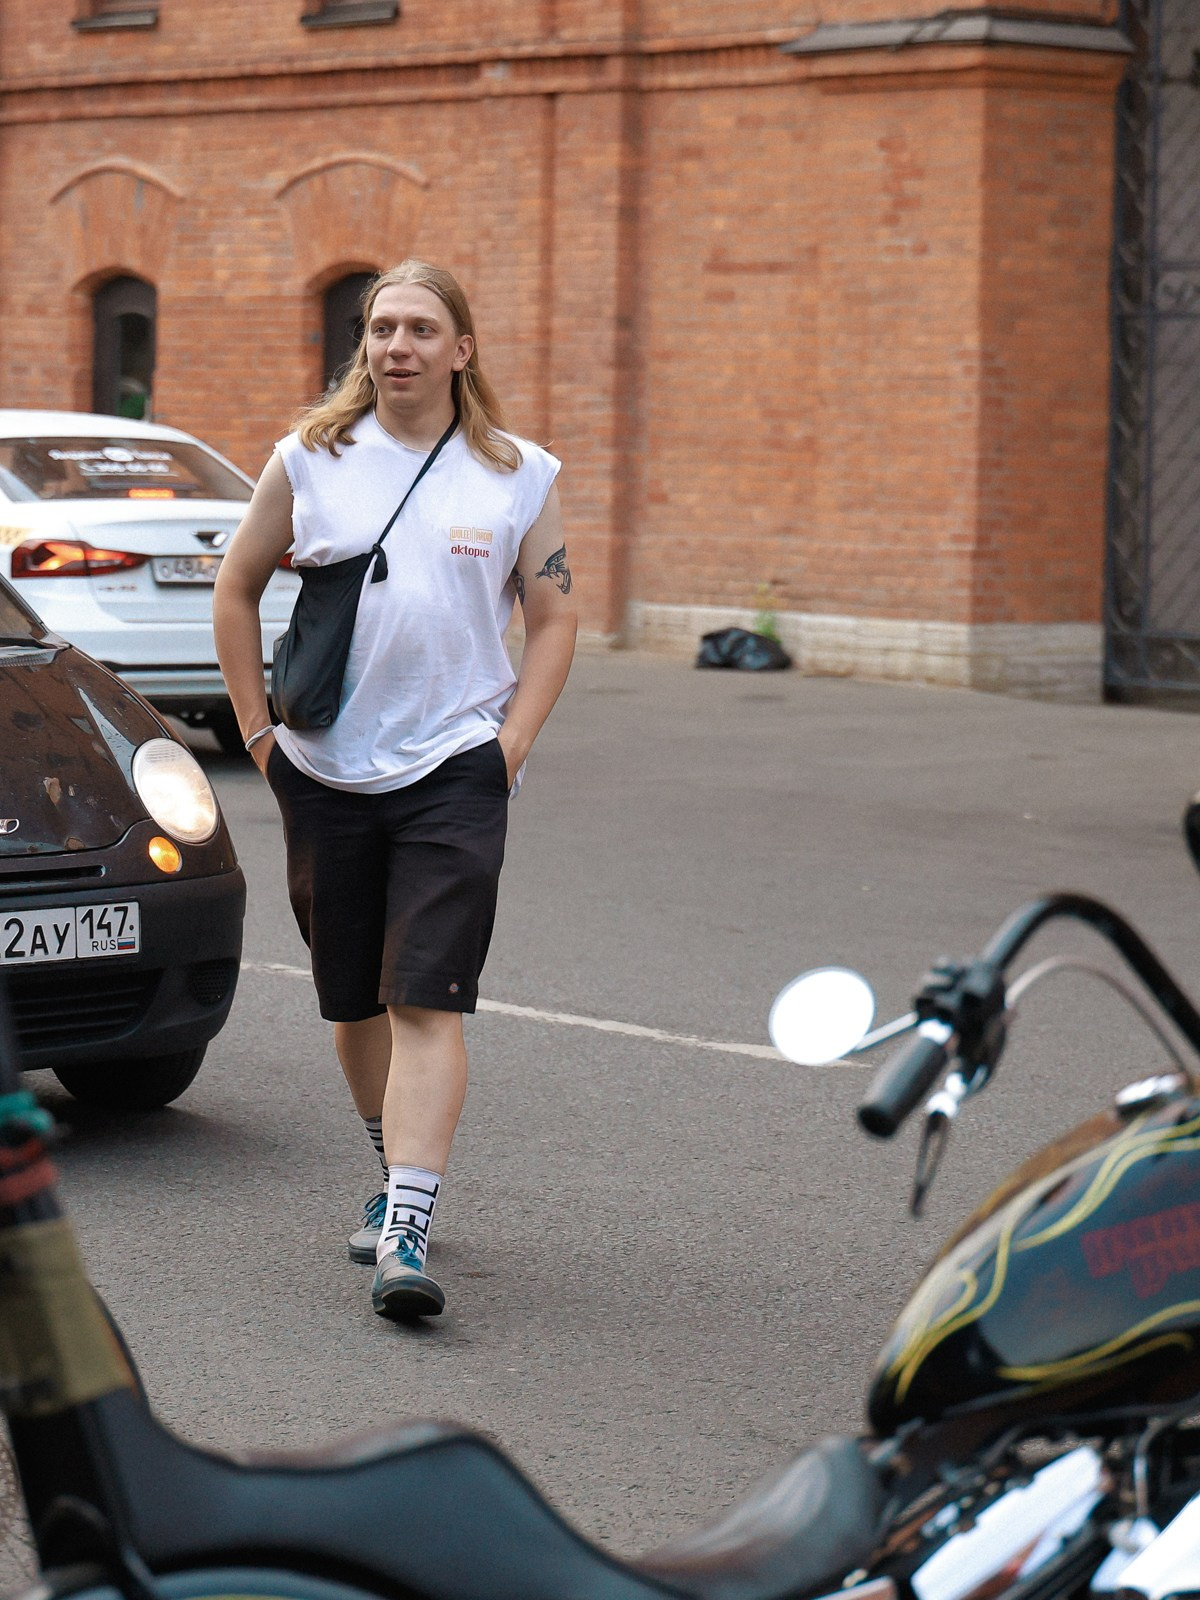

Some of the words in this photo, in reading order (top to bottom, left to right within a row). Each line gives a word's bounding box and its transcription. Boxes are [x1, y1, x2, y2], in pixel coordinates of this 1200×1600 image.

[451, 545, 490, 558] oktopus
[80, 905, 129, 939] 147
[91, 940, 117, 951] RUS
[384, 1183, 440, 1257] HELL
